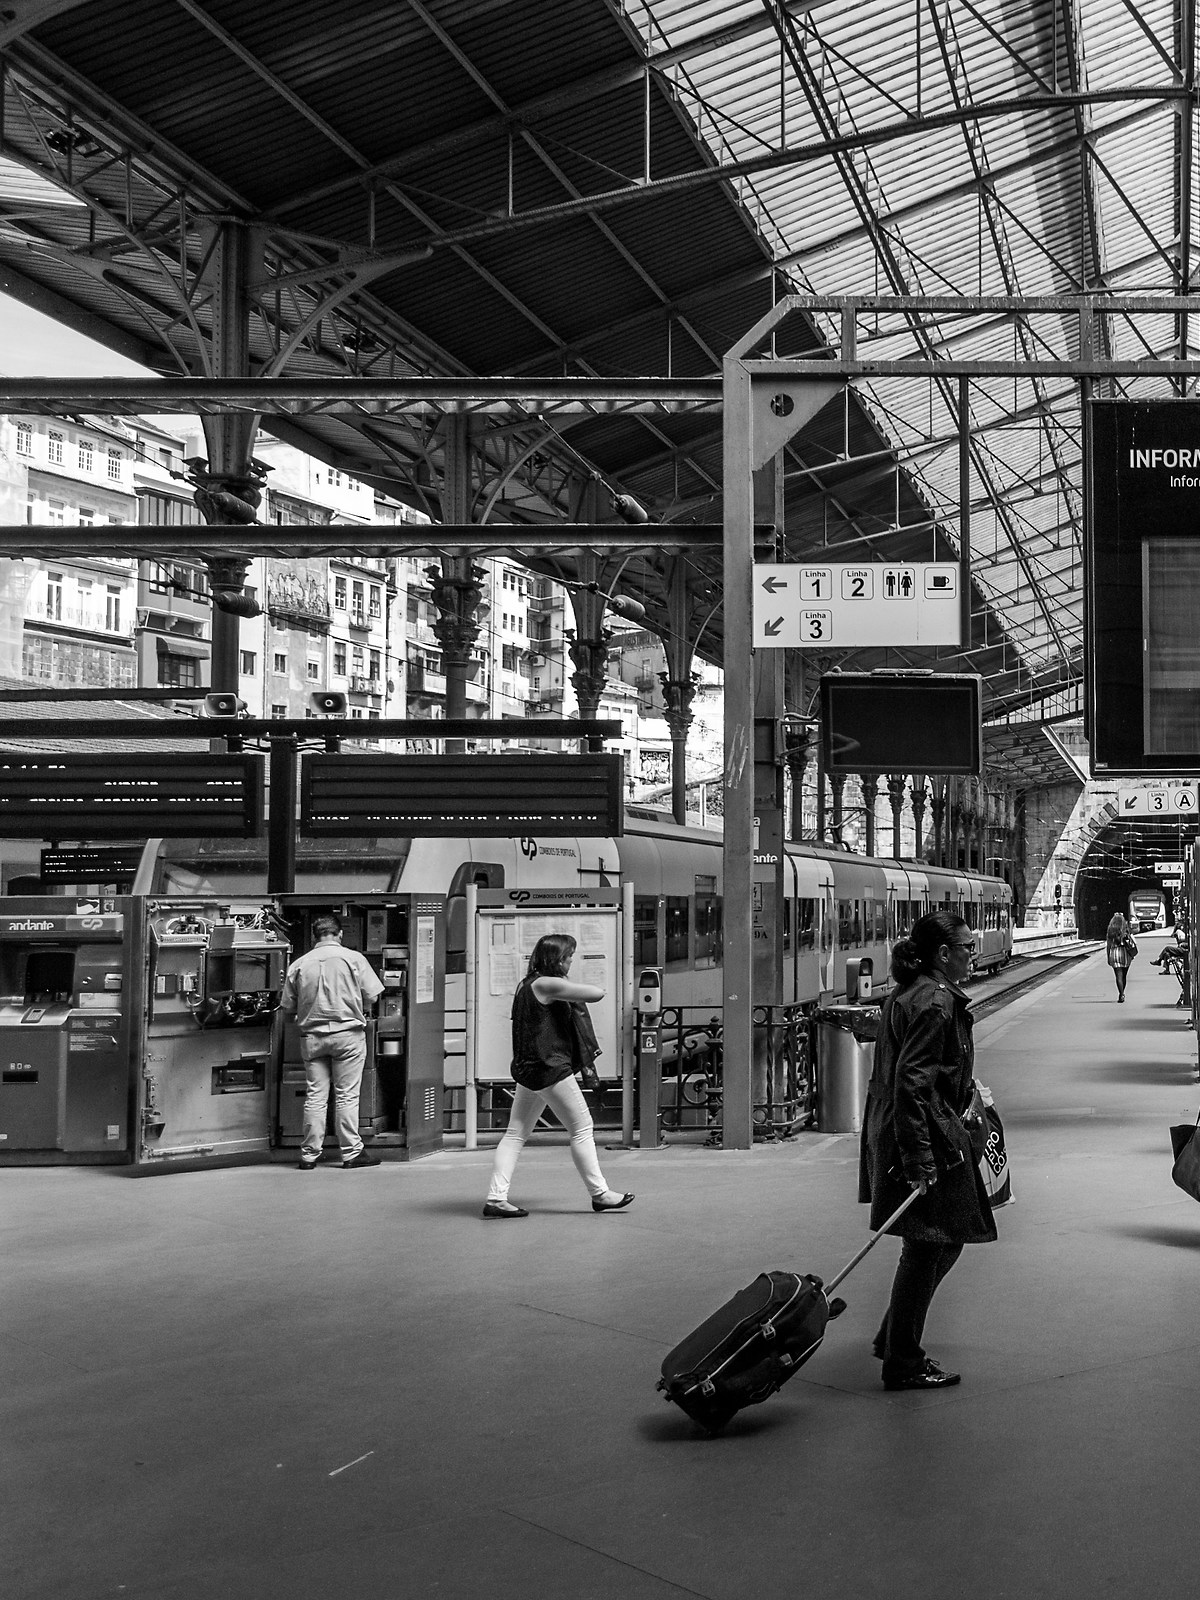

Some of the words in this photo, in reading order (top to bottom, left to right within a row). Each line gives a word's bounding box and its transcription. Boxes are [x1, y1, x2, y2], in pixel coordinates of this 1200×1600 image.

[805, 570, 826, 578] Linha
[811, 578, 821, 597] 1
[851, 577, 865, 597] 2
[809, 620, 823, 639] 3
[1154, 797, 1163, 810] 3
[1179, 794, 1191, 807] A
[8, 919, 54, 931] andante
